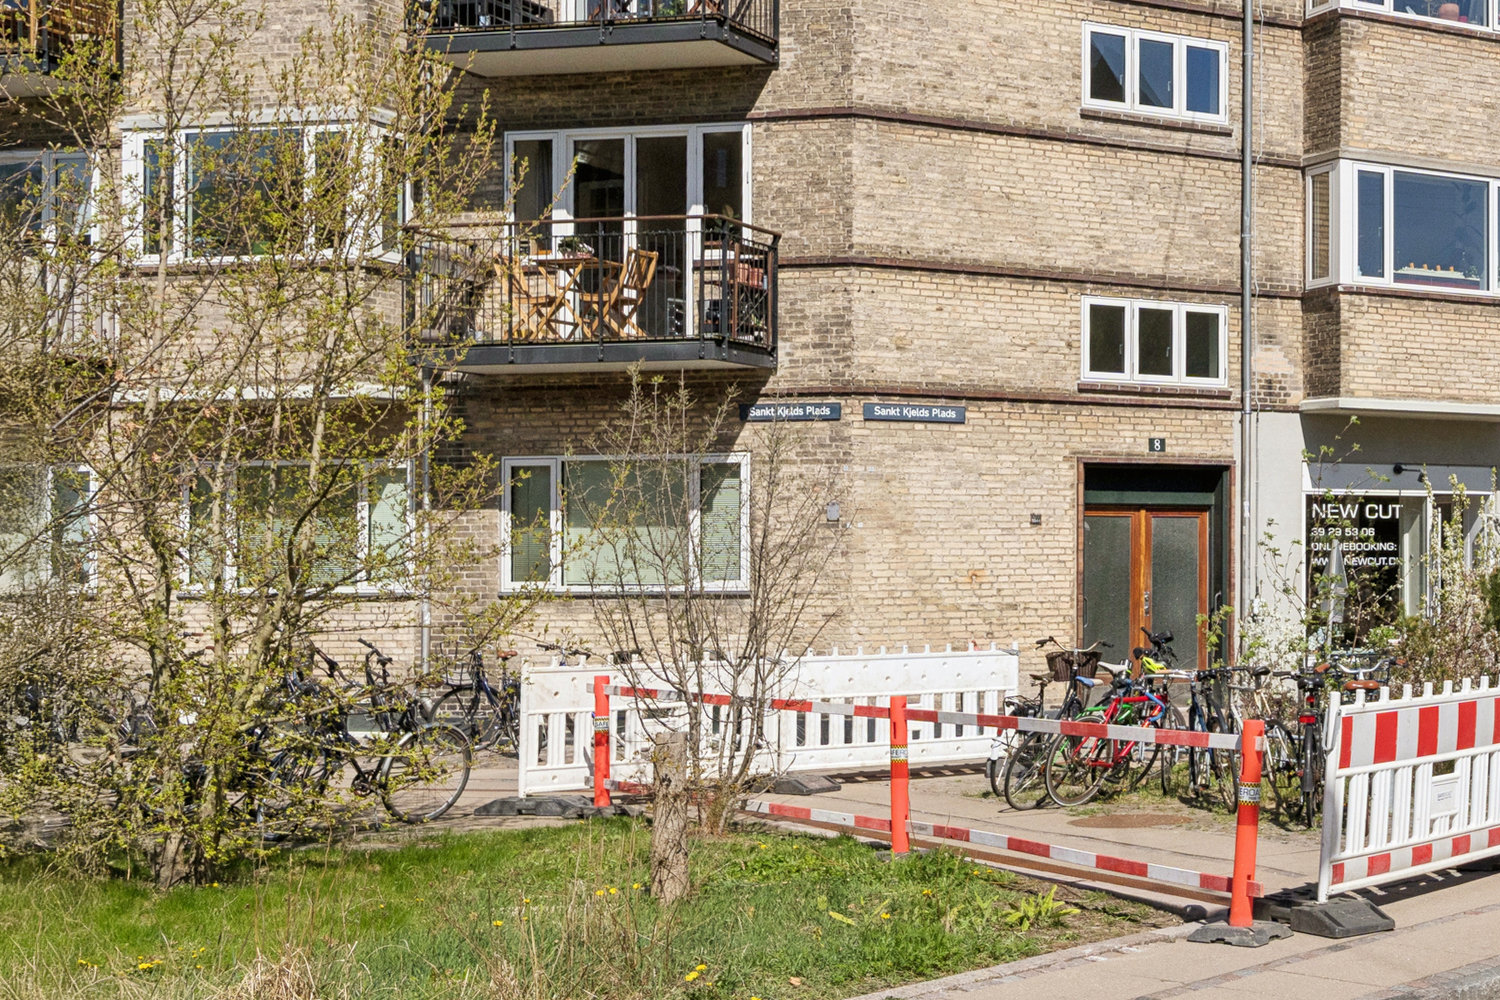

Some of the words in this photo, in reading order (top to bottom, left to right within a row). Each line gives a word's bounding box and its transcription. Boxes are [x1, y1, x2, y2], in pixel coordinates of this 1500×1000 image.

[750, 407, 774, 416] Sankt
[777, 406, 804, 417] Kjelds
[806, 406, 831, 415] Plads
[874, 406, 900, 416] Sankt
[903, 407, 930, 418] Kjelds
[932, 408, 957, 418] Plads
[1154, 439, 1161, 451] 8
[1312, 503, 1359, 519] NEW
[1365, 504, 1403, 519] CUT
[1311, 527, 1325, 536] 39
[1344, 527, 1359, 536] 53
[1361, 527, 1375, 536] 06
[1311, 542, 1397, 551] ONLEBOOKING:
